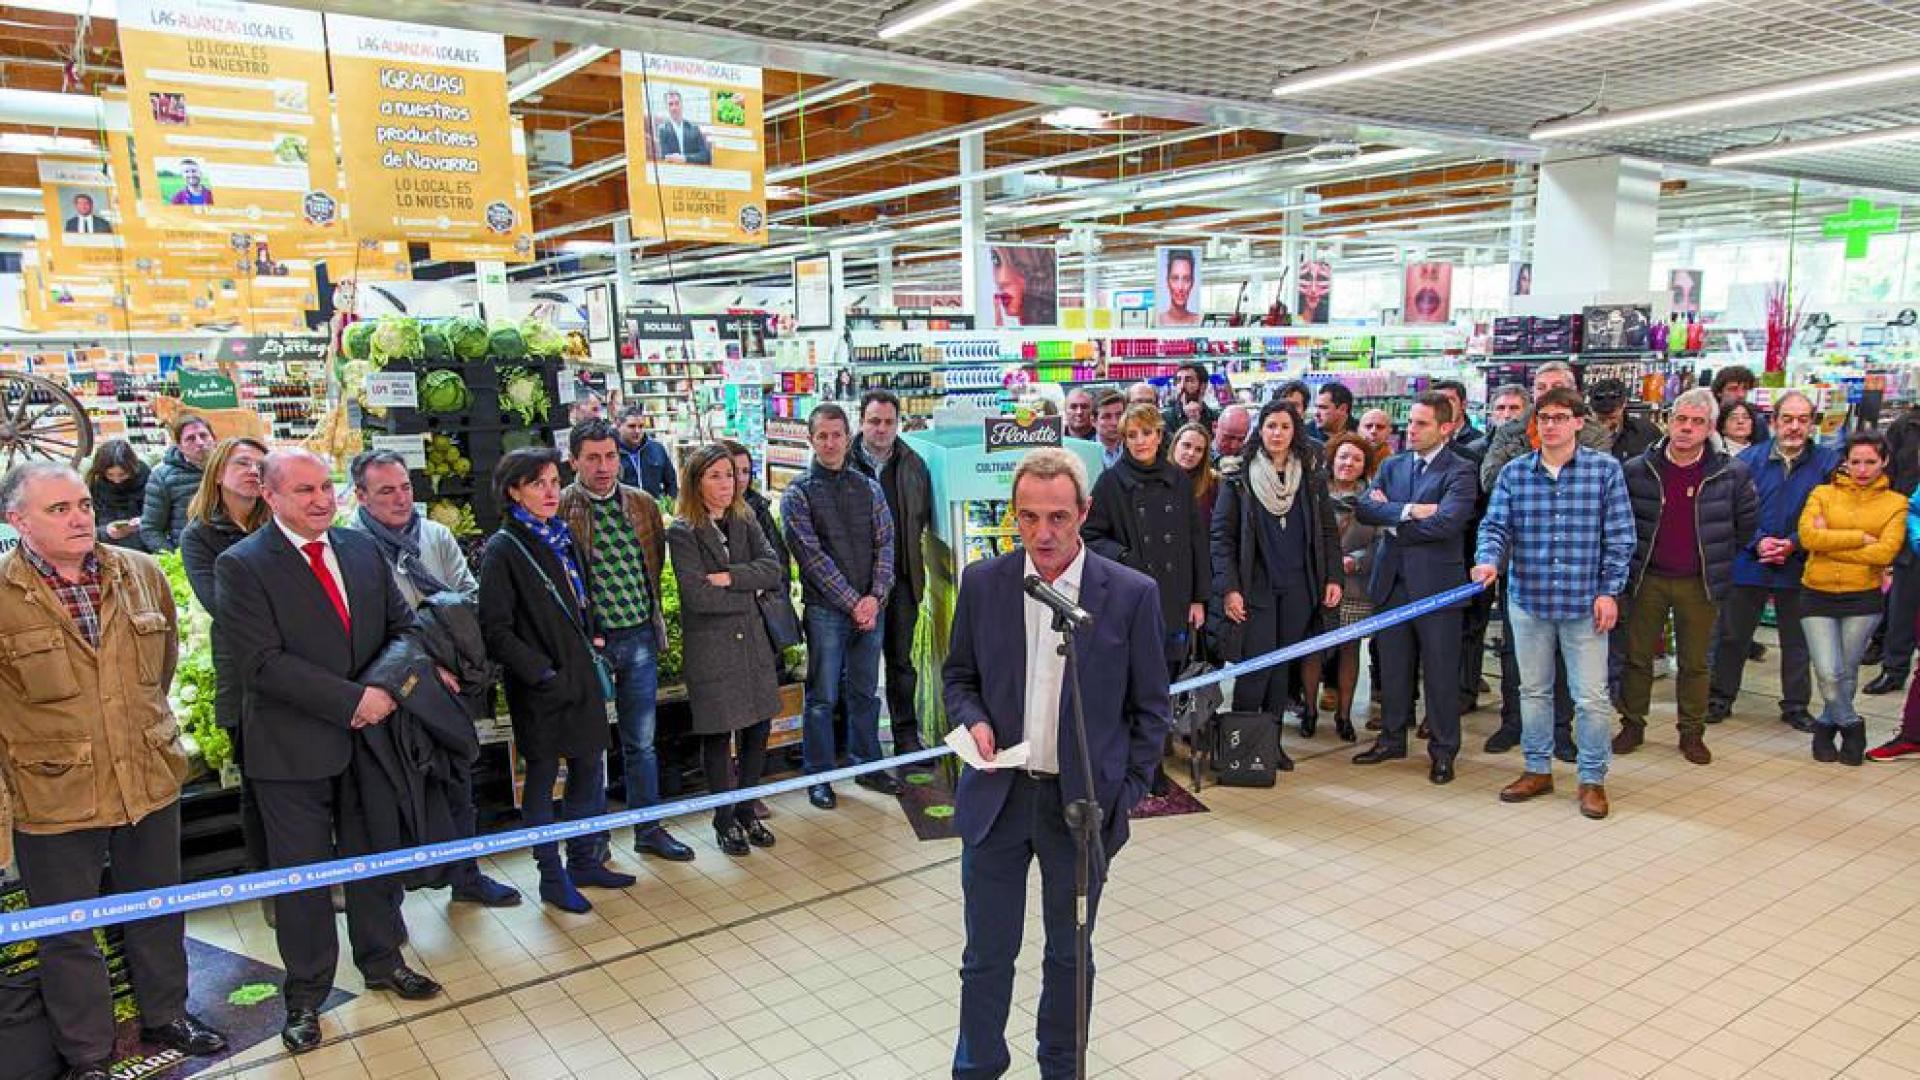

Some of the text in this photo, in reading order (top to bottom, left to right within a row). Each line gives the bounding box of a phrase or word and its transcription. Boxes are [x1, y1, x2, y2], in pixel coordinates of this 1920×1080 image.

[151, 10, 294, 40] LAS ALIANZAS LOCALES
[187, 40, 267, 59] LO LOCAL ES
[358, 36, 379, 51] LAS
[436, 45, 480, 63] LOCALES
[189, 55, 270, 74] LO NUESTRO
[380, 99, 471, 121] a nuestros
[376, 125, 478, 147] productores
[383, 148, 479, 173] de Navarra
[394, 177, 472, 195] LO LOCAL ES
[396, 193, 475, 210] LO NUESTRO
[258, 338, 328, 358] Lizarrag
[990, 421, 1058, 445] Florette
